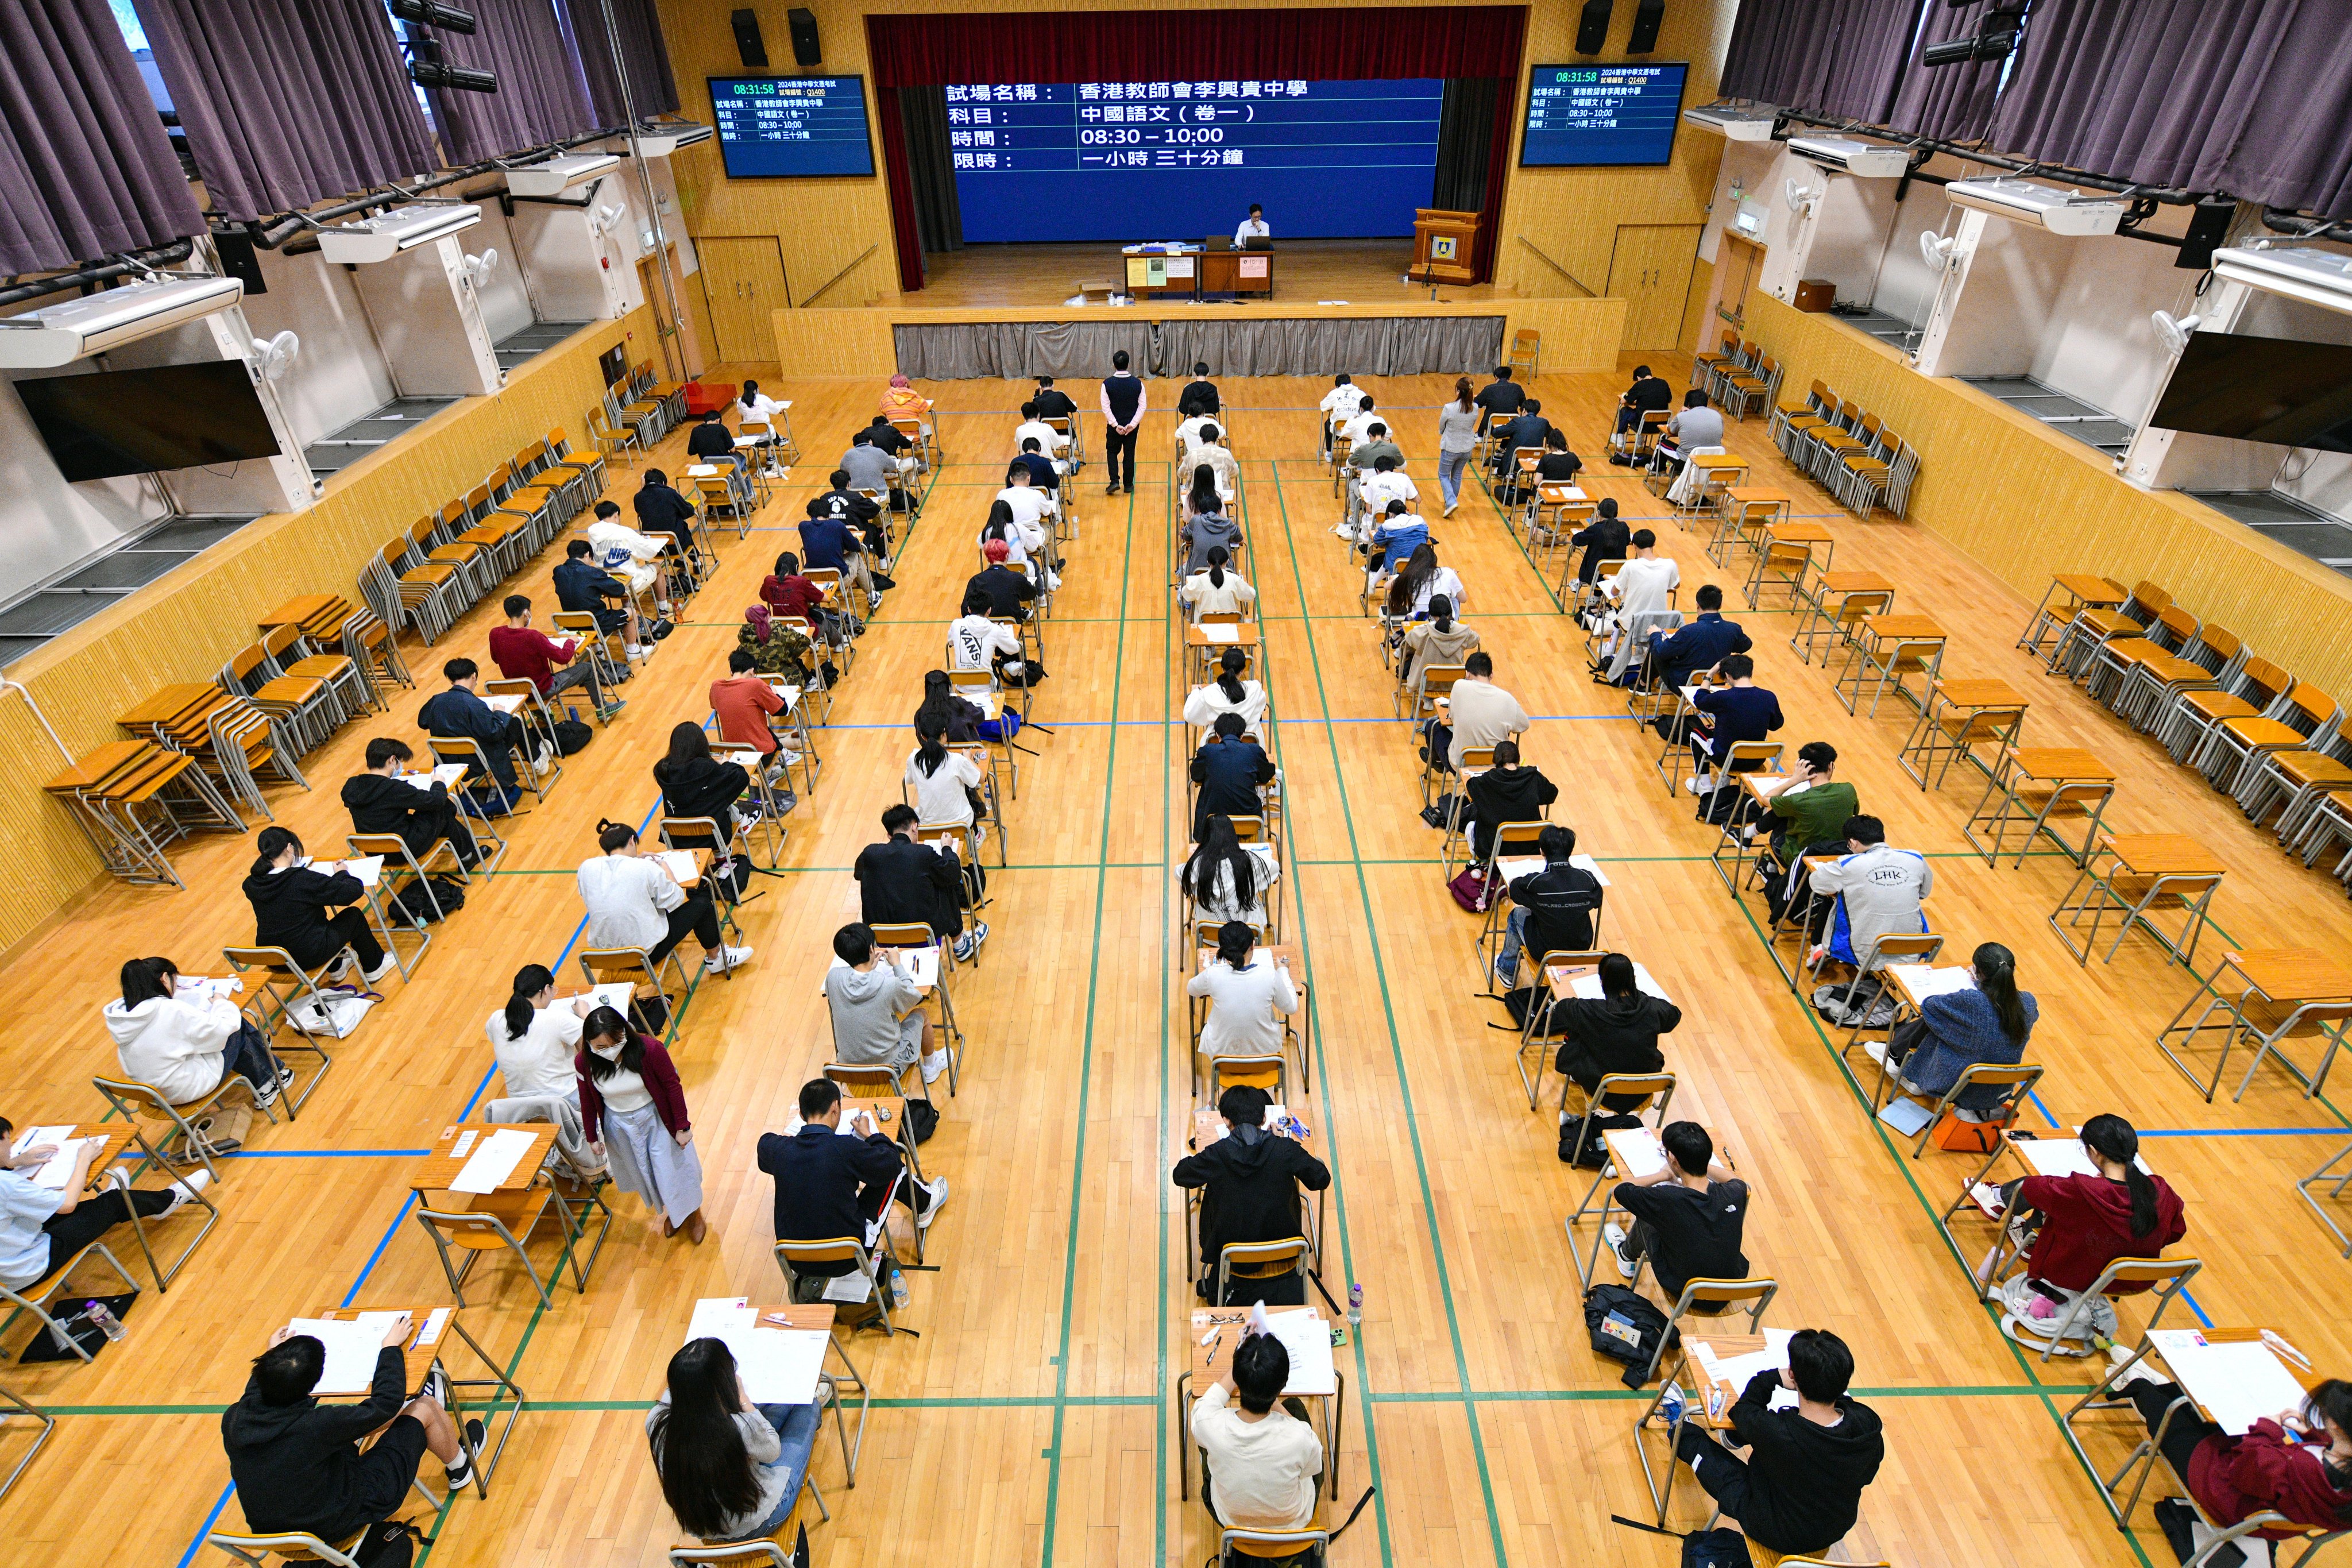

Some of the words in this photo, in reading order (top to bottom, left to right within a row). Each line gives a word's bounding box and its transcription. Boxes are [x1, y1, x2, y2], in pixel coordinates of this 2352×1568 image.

[1556, 72, 1597, 82] 08:31:58
[733, 84, 775, 95] 08:31:58
[1079, 80, 1308, 100] 香港教師會李興貴中學
[1573, 87, 1641, 96] 香港教師會李興貴中學
[755, 99, 823, 107] 香港教師會李興貴中學
[949, 107, 1008, 125] 科目：
[1569, 109, 1588, 117] 08:30
[1594, 109, 1613, 117] 10:00
[759, 121, 777, 129] 08:30
[784, 121, 802, 129] 10:00
[1568, 119, 1589, 128] 一小時
[1589, 119, 1617, 128] 三十分鐘
[761, 131, 781, 140] 一小時
[783, 131, 810, 140] 三十分鐘
[951, 130, 1010, 146] 時間：
[1080, 129, 1140, 145] 08:30
[1165, 128, 1223, 144] 10:00
[953, 152, 1011, 169] 限時：
[1083, 150, 1148, 167] 一小時
[1155, 149, 1243, 166] 三十分鐘
[960, 628, 980, 661] VANS
[1875, 871, 1901, 880] LHK
